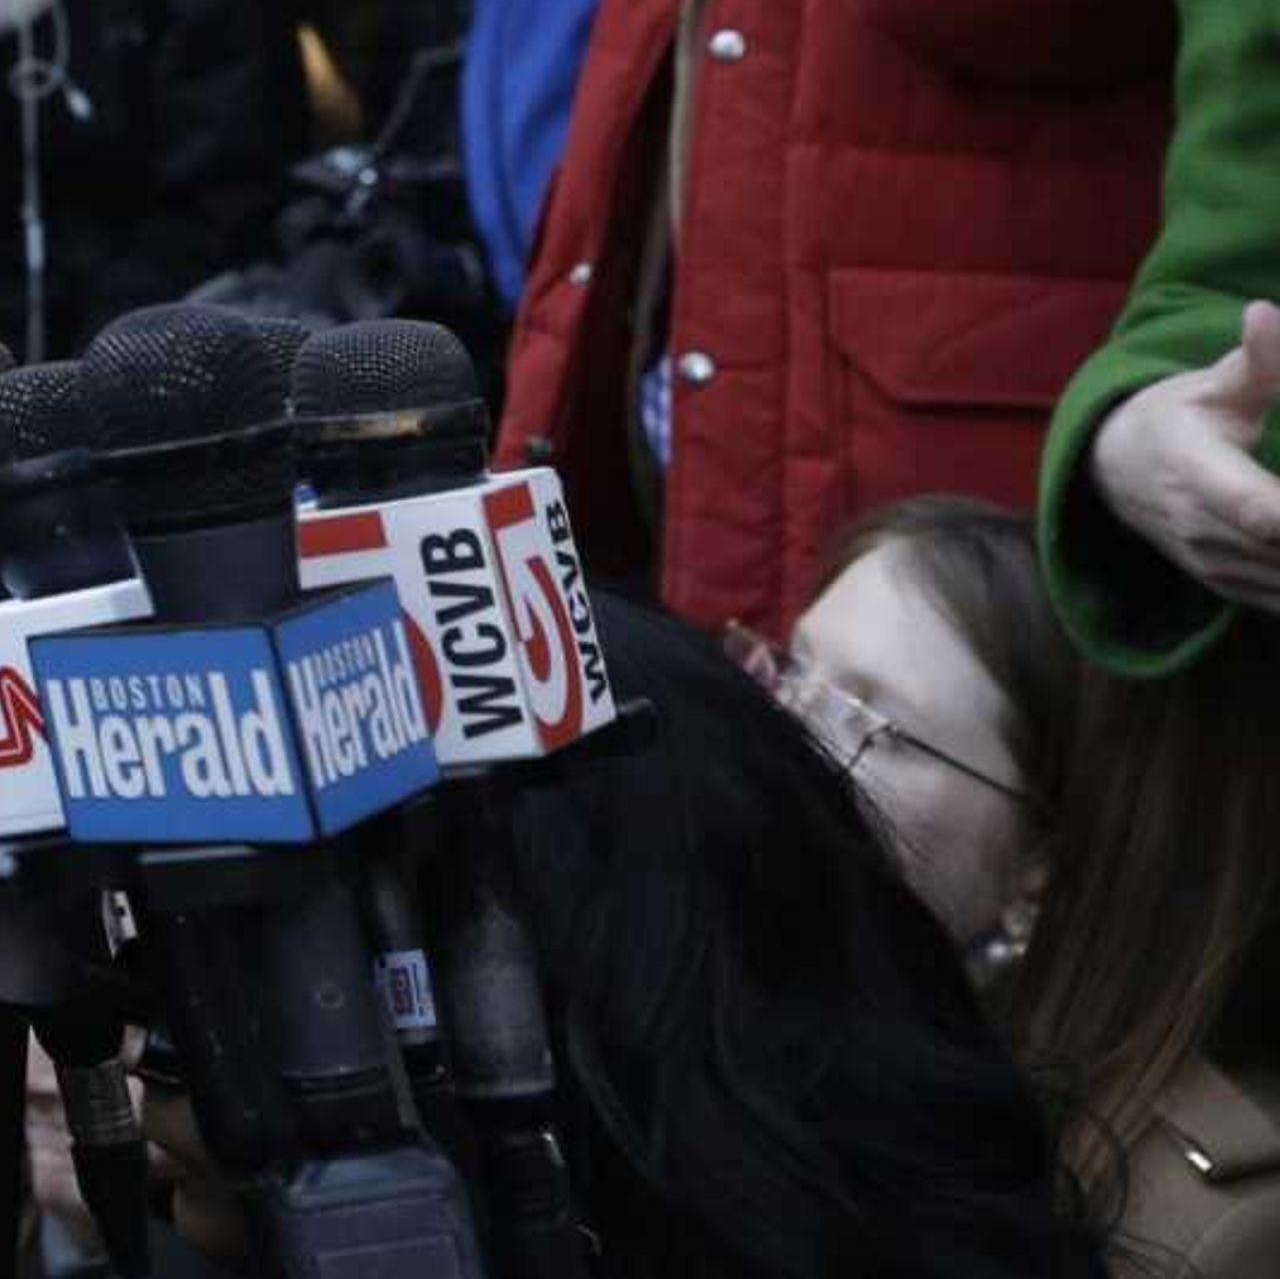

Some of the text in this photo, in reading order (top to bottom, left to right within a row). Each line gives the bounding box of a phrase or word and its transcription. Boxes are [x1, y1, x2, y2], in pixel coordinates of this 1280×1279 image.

[420, 528, 524, 739] WCVB
[545, 500, 608, 706] WCVB
[46, 669, 295, 799] Herald
[90, 674, 206, 712] BOSTON
[287, 619, 430, 789] Herald
